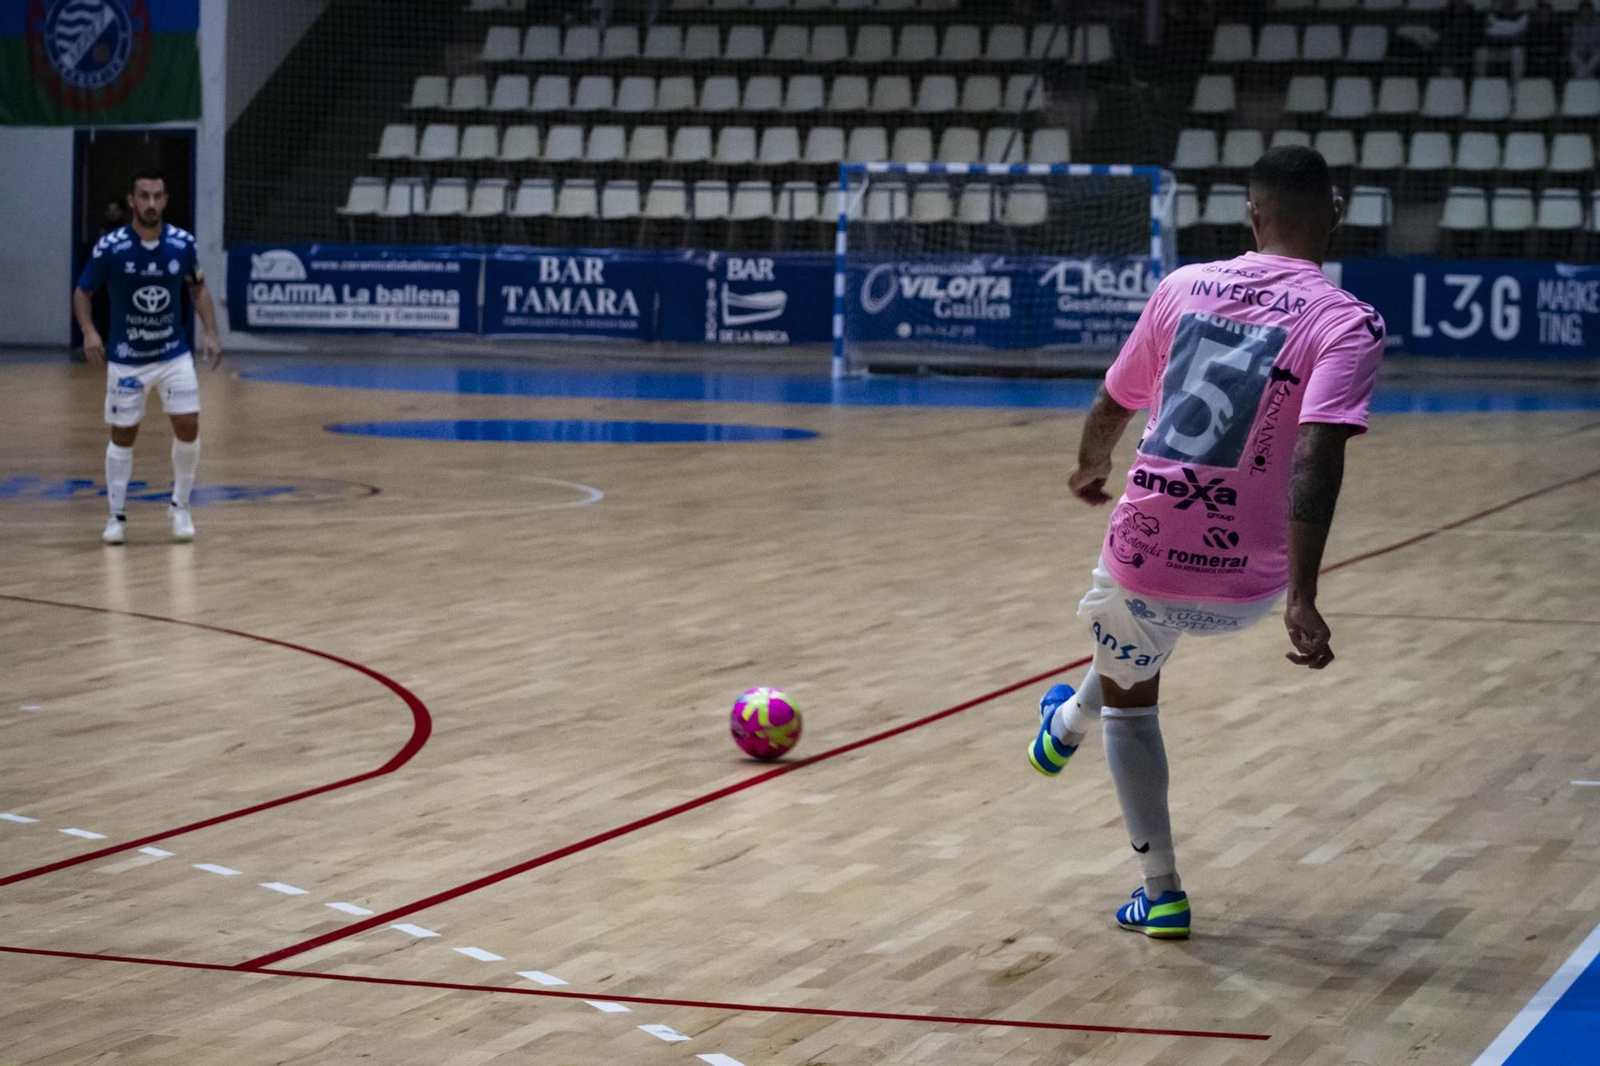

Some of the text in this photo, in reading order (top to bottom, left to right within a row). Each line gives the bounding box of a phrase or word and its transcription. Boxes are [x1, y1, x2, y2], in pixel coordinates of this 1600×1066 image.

[539, 256, 605, 284] BAR
[727, 257, 776, 281] BAR
[343, 284, 370, 304] La
[375, 283, 460, 305] ballena
[502, 286, 640, 316] TAMARA
[1190, 280, 1307, 317] INVERCAR
[1412, 272, 1520, 341] L3G
[1165, 337, 1253, 456] 5
[1207, 512, 1235, 521] group
[1168, 548, 1249, 568] romeral
